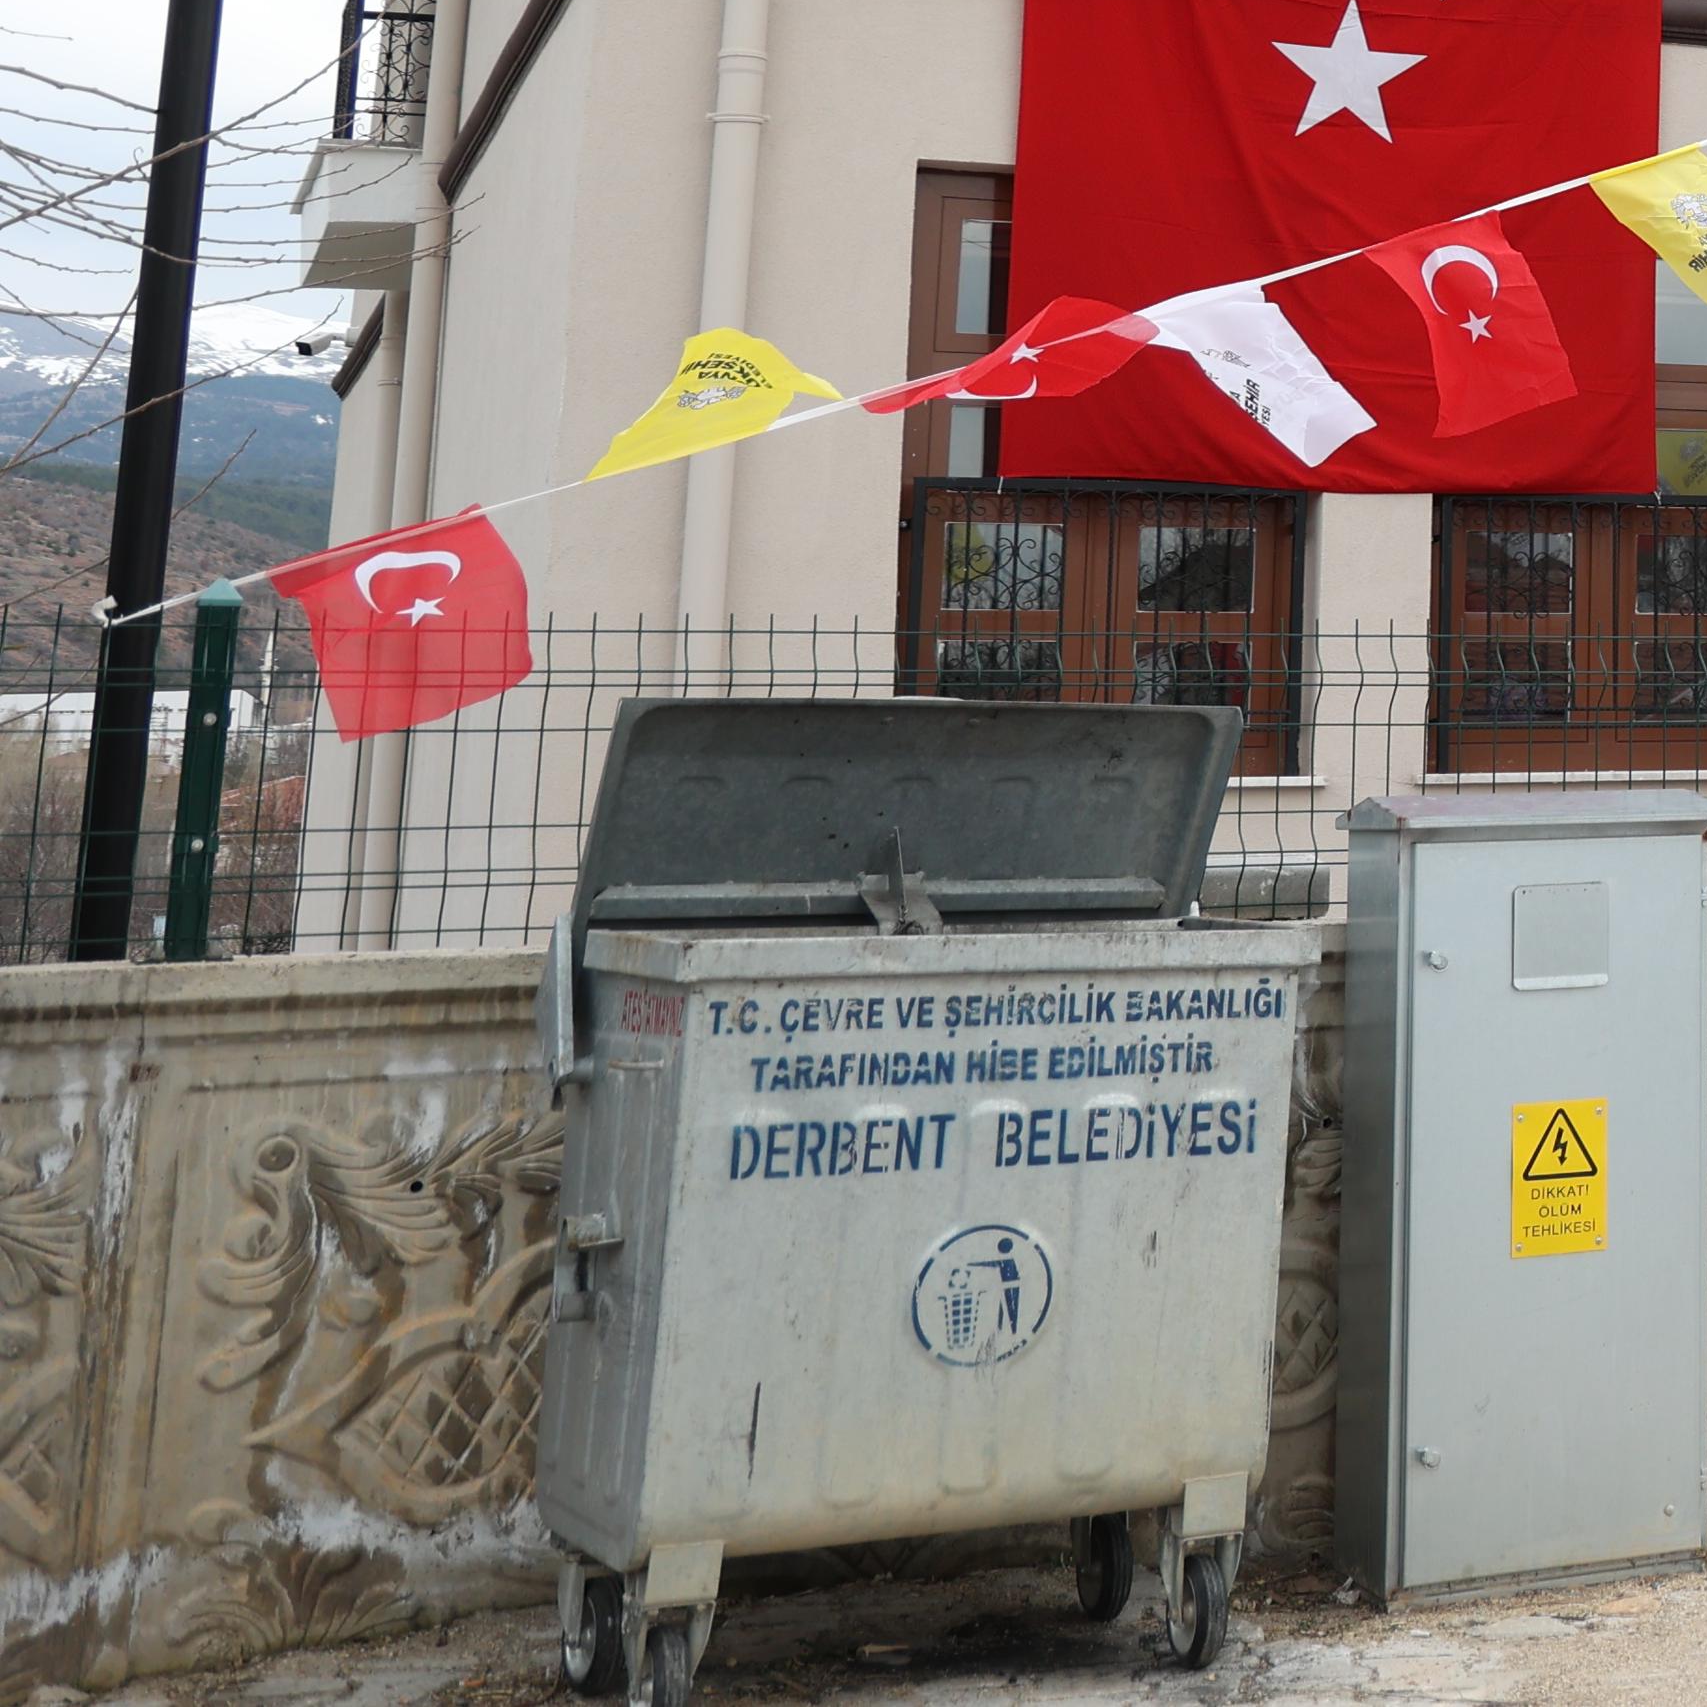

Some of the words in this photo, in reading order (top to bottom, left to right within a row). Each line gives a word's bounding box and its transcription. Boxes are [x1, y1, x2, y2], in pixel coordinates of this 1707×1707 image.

[780, 998, 885, 1043] ÇEVRE
[896, 996, 935, 1029] VE
[944, 983, 1116, 1038] ŞEHİRCİLİK
[1125, 978, 1283, 1023] BAKANLIĞI
[751, 1050, 956, 1092] TARAFINDAN
[966, 1039, 1038, 1083] HİBE
[1048, 1032, 1213, 1083] EDİLMİŞTİR
[730, 1113, 957, 1181] DERBENT
[995, 1097, 1257, 1168] BELEDİYESİ
[1531, 1184, 1589, 1200] DİKKAT!
[1539, 1202, 1582, 1218] ÖLÜM
[1522, 1218, 1596, 1238] TEHLİKESİ
